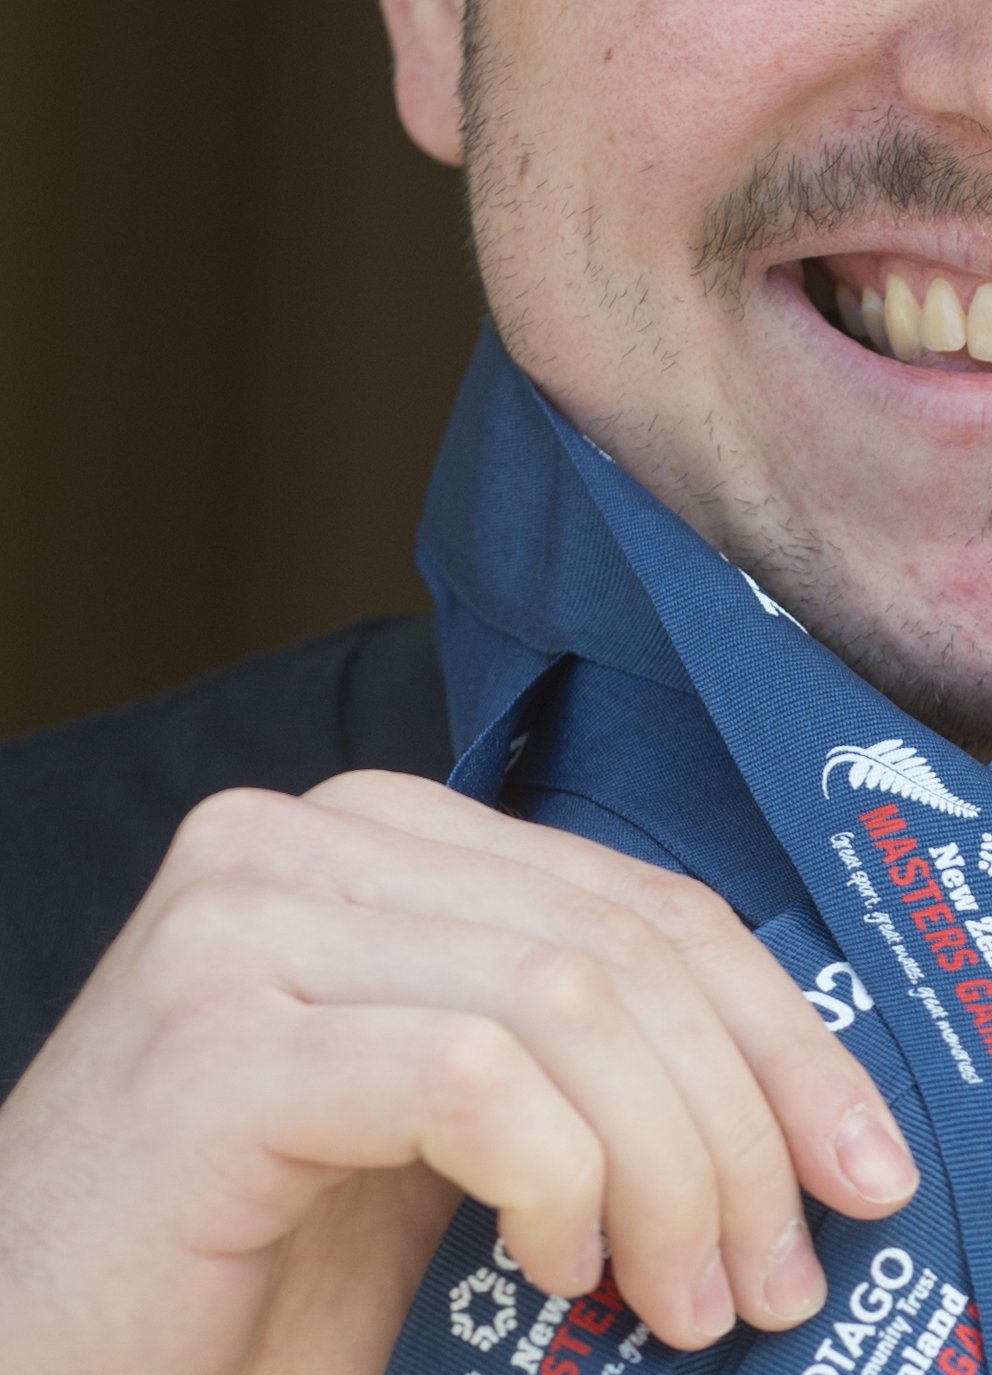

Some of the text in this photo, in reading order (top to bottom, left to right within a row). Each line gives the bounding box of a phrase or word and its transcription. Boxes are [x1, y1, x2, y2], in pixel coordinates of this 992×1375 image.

[830, 831, 863, 869] Great
[863, 912, 903, 945] great
[859, 803, 980, 972] MASTERS
[928, 842, 979, 911] New
[896, 1268, 938, 1316] Trust
[511, 1295, 571, 1375] New
